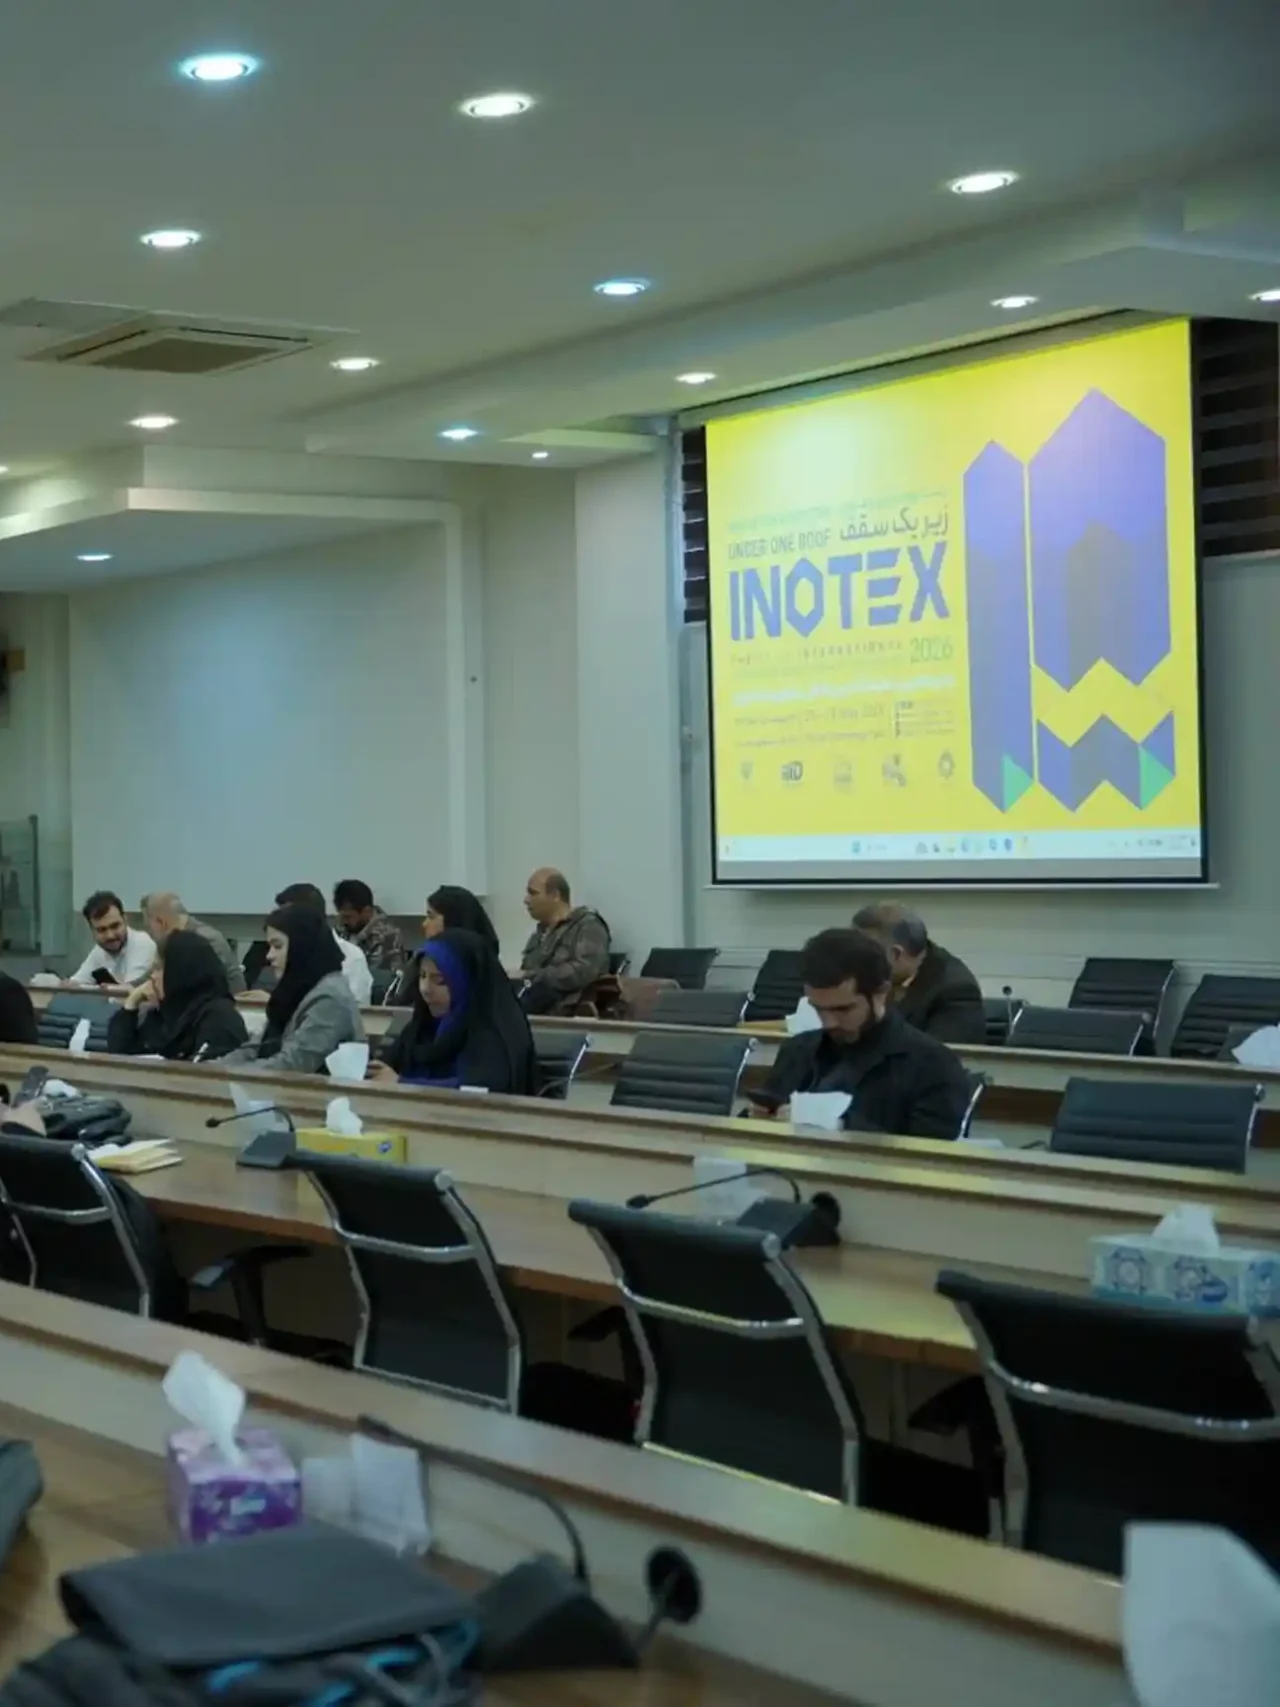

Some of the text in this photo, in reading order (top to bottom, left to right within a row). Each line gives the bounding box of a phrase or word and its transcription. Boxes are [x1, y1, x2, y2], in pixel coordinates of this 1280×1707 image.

[839, 511, 889, 541] سقف
[893, 506, 918, 540] یک
[923, 504, 949, 538] زیر
[770, 533, 796, 554] ONE
[729, 540, 950, 642] INOTEX
